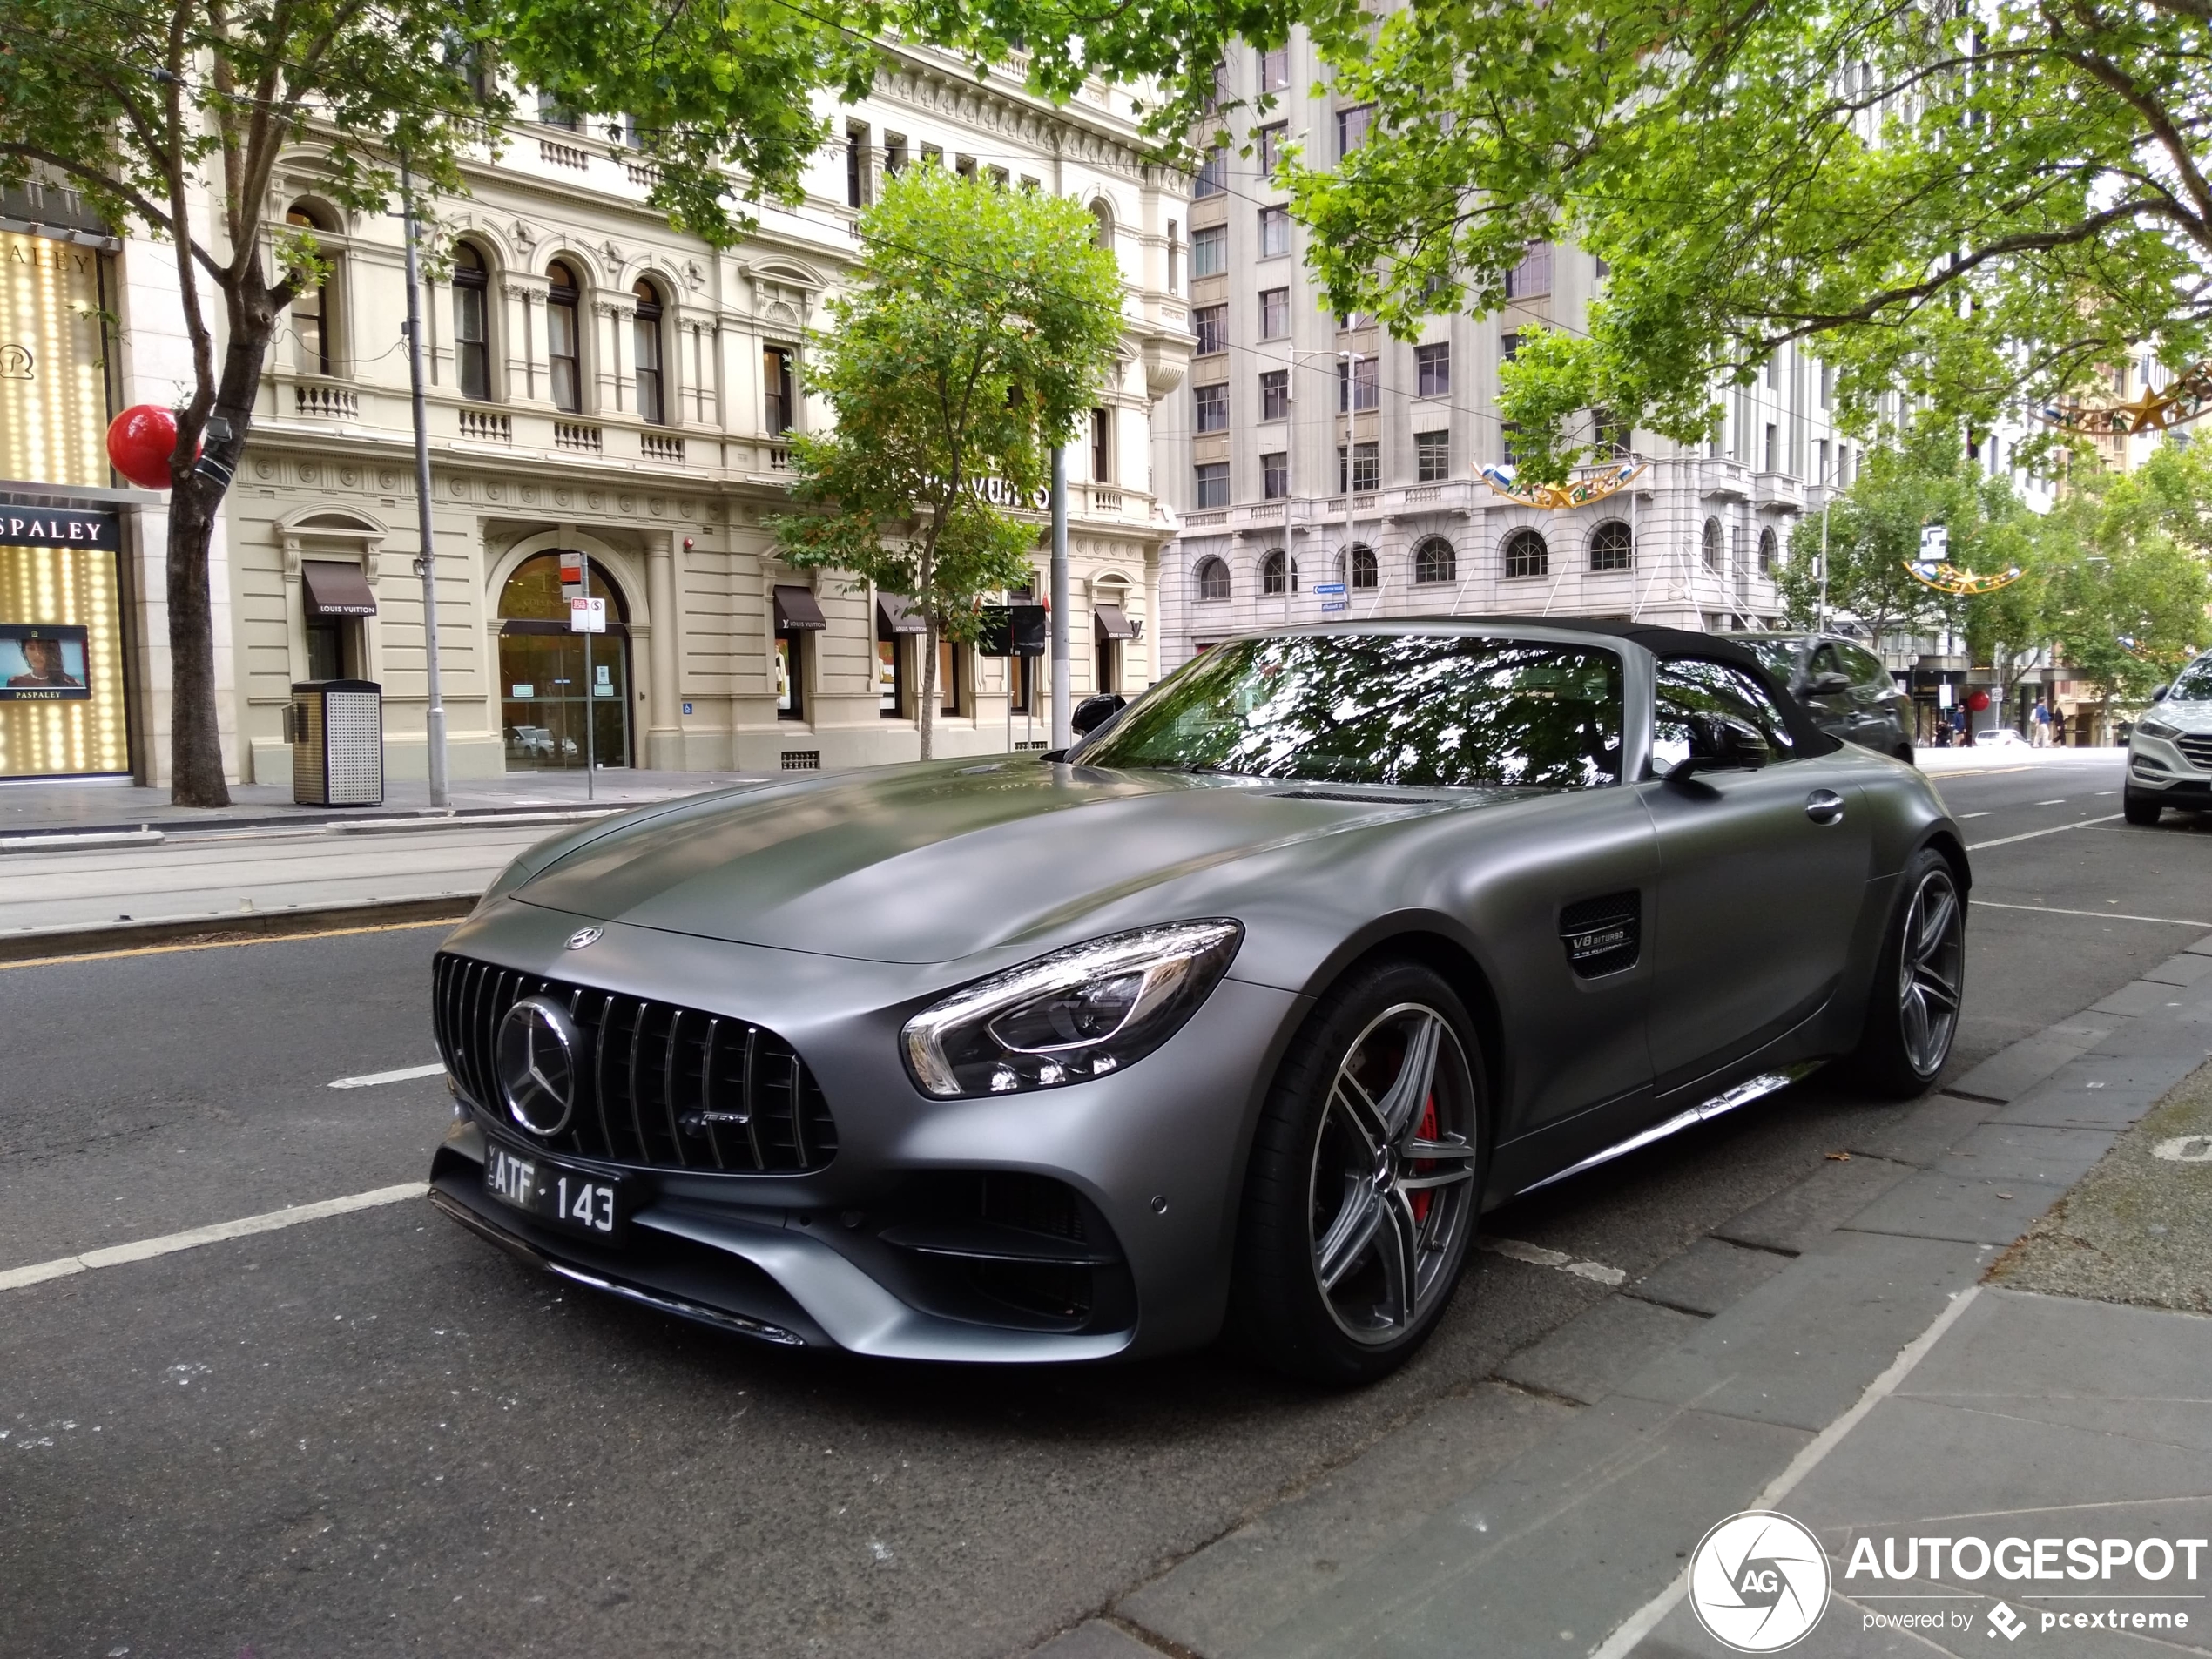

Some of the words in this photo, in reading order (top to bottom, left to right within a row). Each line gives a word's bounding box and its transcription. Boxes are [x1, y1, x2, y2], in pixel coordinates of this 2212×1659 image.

[539, 572, 563, 594] 13
[1573, 935, 1592, 948] V8
[1593, 931, 1624, 944] BITURBO
[495, 1151, 535, 1204] ATF
[557, 1177, 614, 1231] 143
